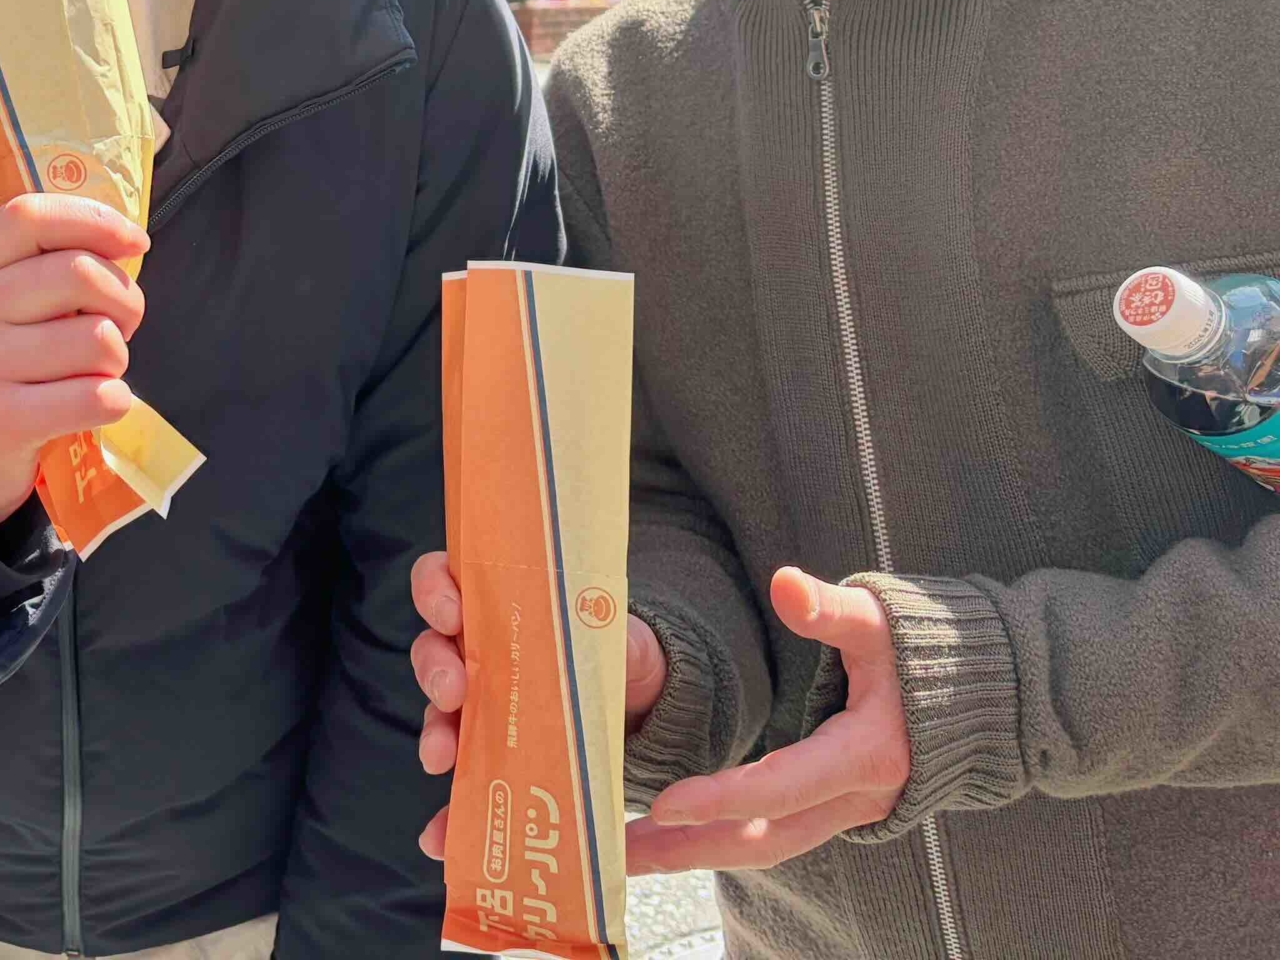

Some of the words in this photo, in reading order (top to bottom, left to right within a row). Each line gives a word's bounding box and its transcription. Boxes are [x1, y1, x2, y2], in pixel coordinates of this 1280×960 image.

[490, 790, 506, 872] お肉屋さんの
